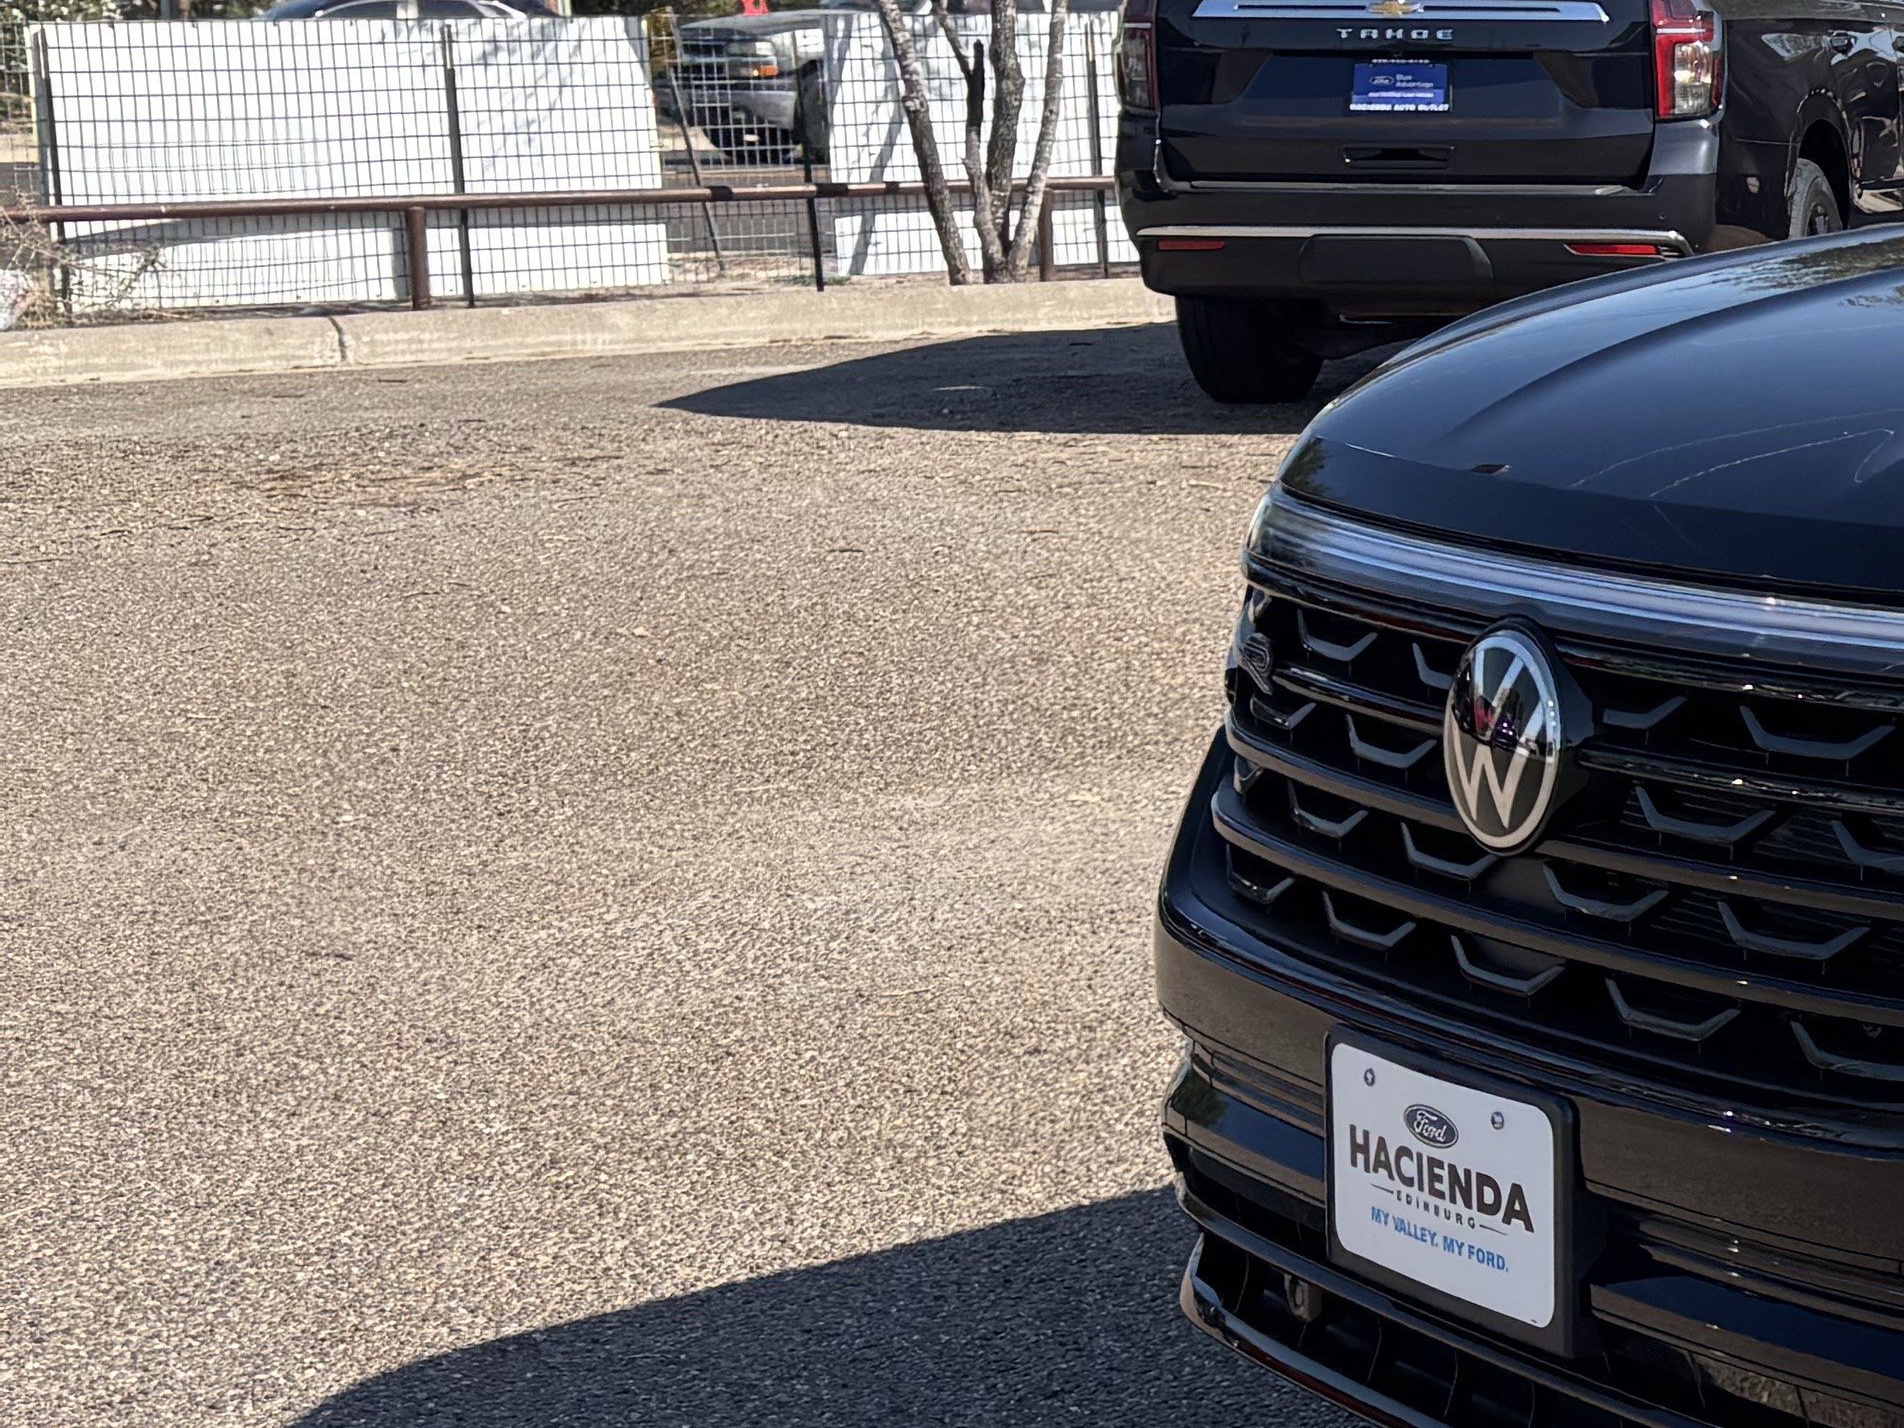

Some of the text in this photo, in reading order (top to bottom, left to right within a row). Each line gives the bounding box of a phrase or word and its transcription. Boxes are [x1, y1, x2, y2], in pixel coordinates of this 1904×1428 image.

[1336, 28, 1453, 40] TAHOE
[1412, 1109, 1448, 1143] Ford
[1349, 1123, 1536, 1234] HACIENDA
[1395, 1189, 1477, 1230] EDINBURG
[1370, 1205, 1390, 1226] MY
[1442, 1234, 1465, 1258] MY
[1467, 1243, 1509, 1273] FORD.
